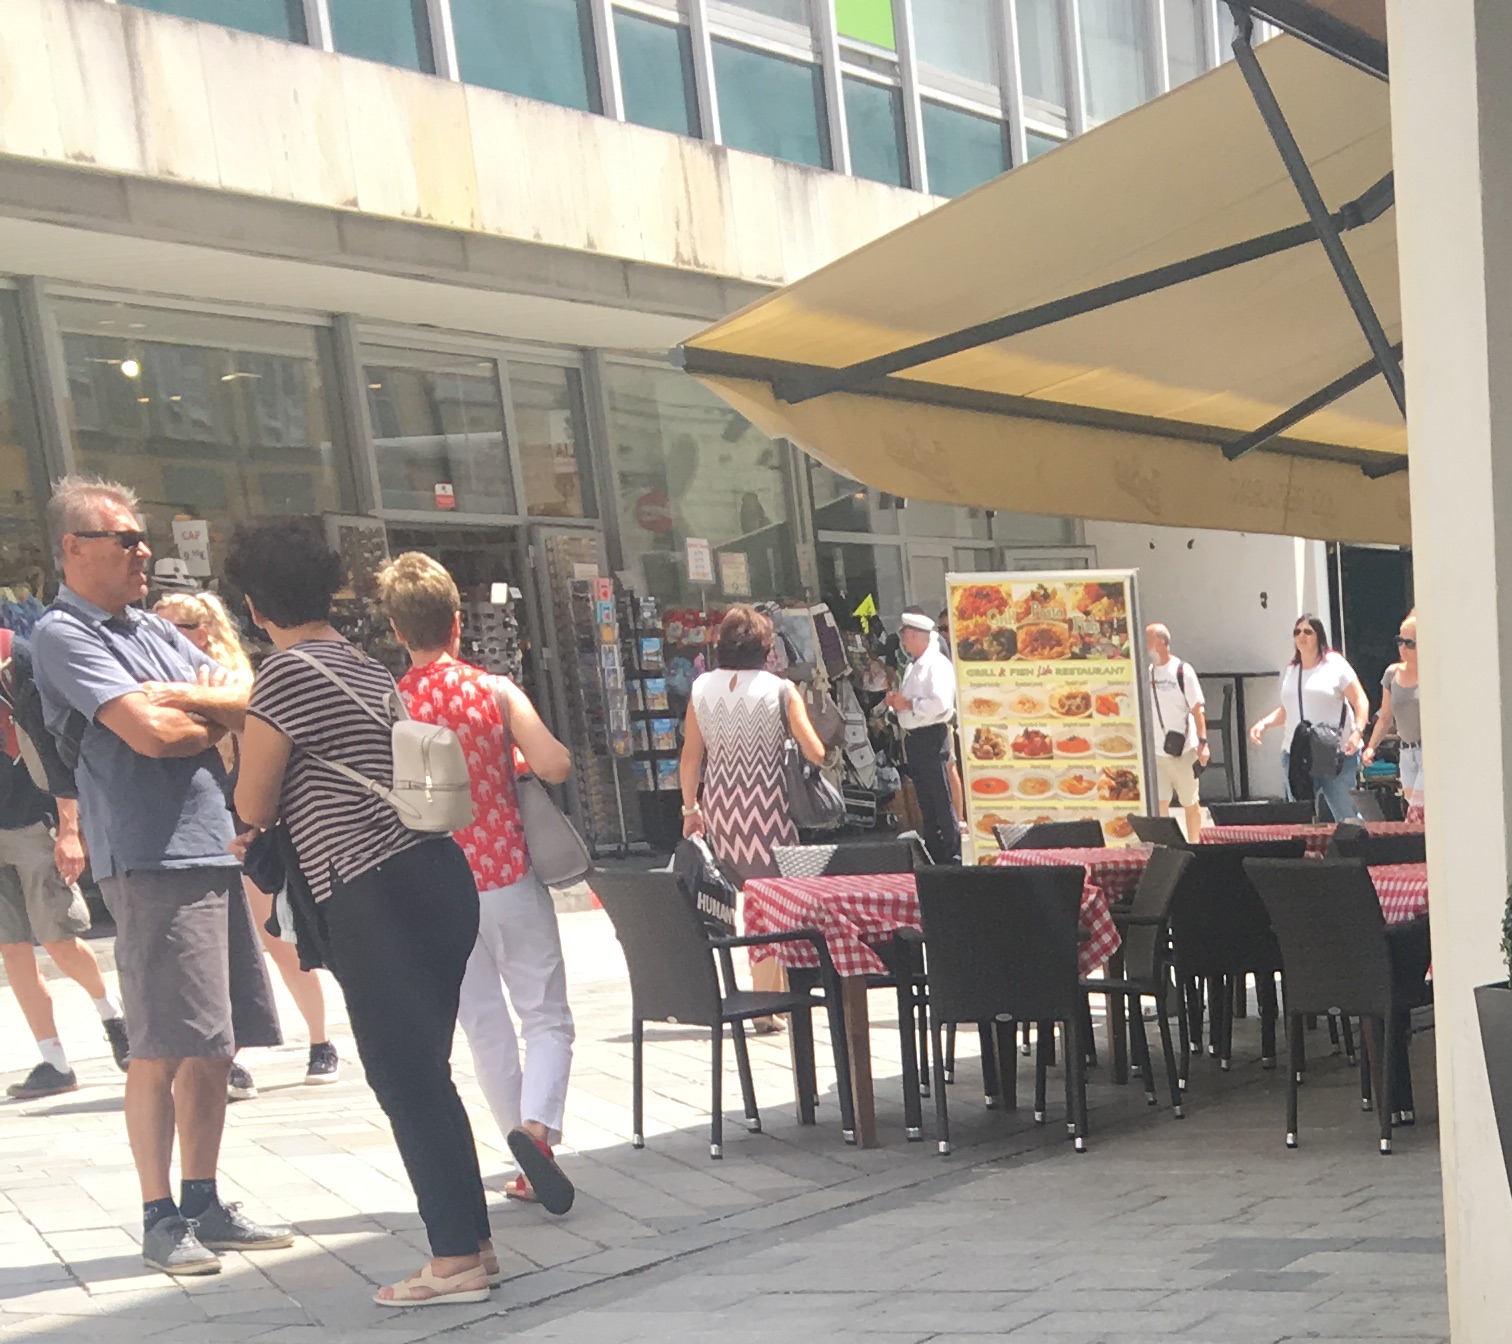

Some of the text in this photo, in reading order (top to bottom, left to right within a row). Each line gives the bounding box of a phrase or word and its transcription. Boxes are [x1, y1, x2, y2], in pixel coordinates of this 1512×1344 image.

[966, 667, 997, 677] GRILL
[1009, 667, 1035, 676] FISH
[1055, 666, 1126, 676] RESTAURANT
